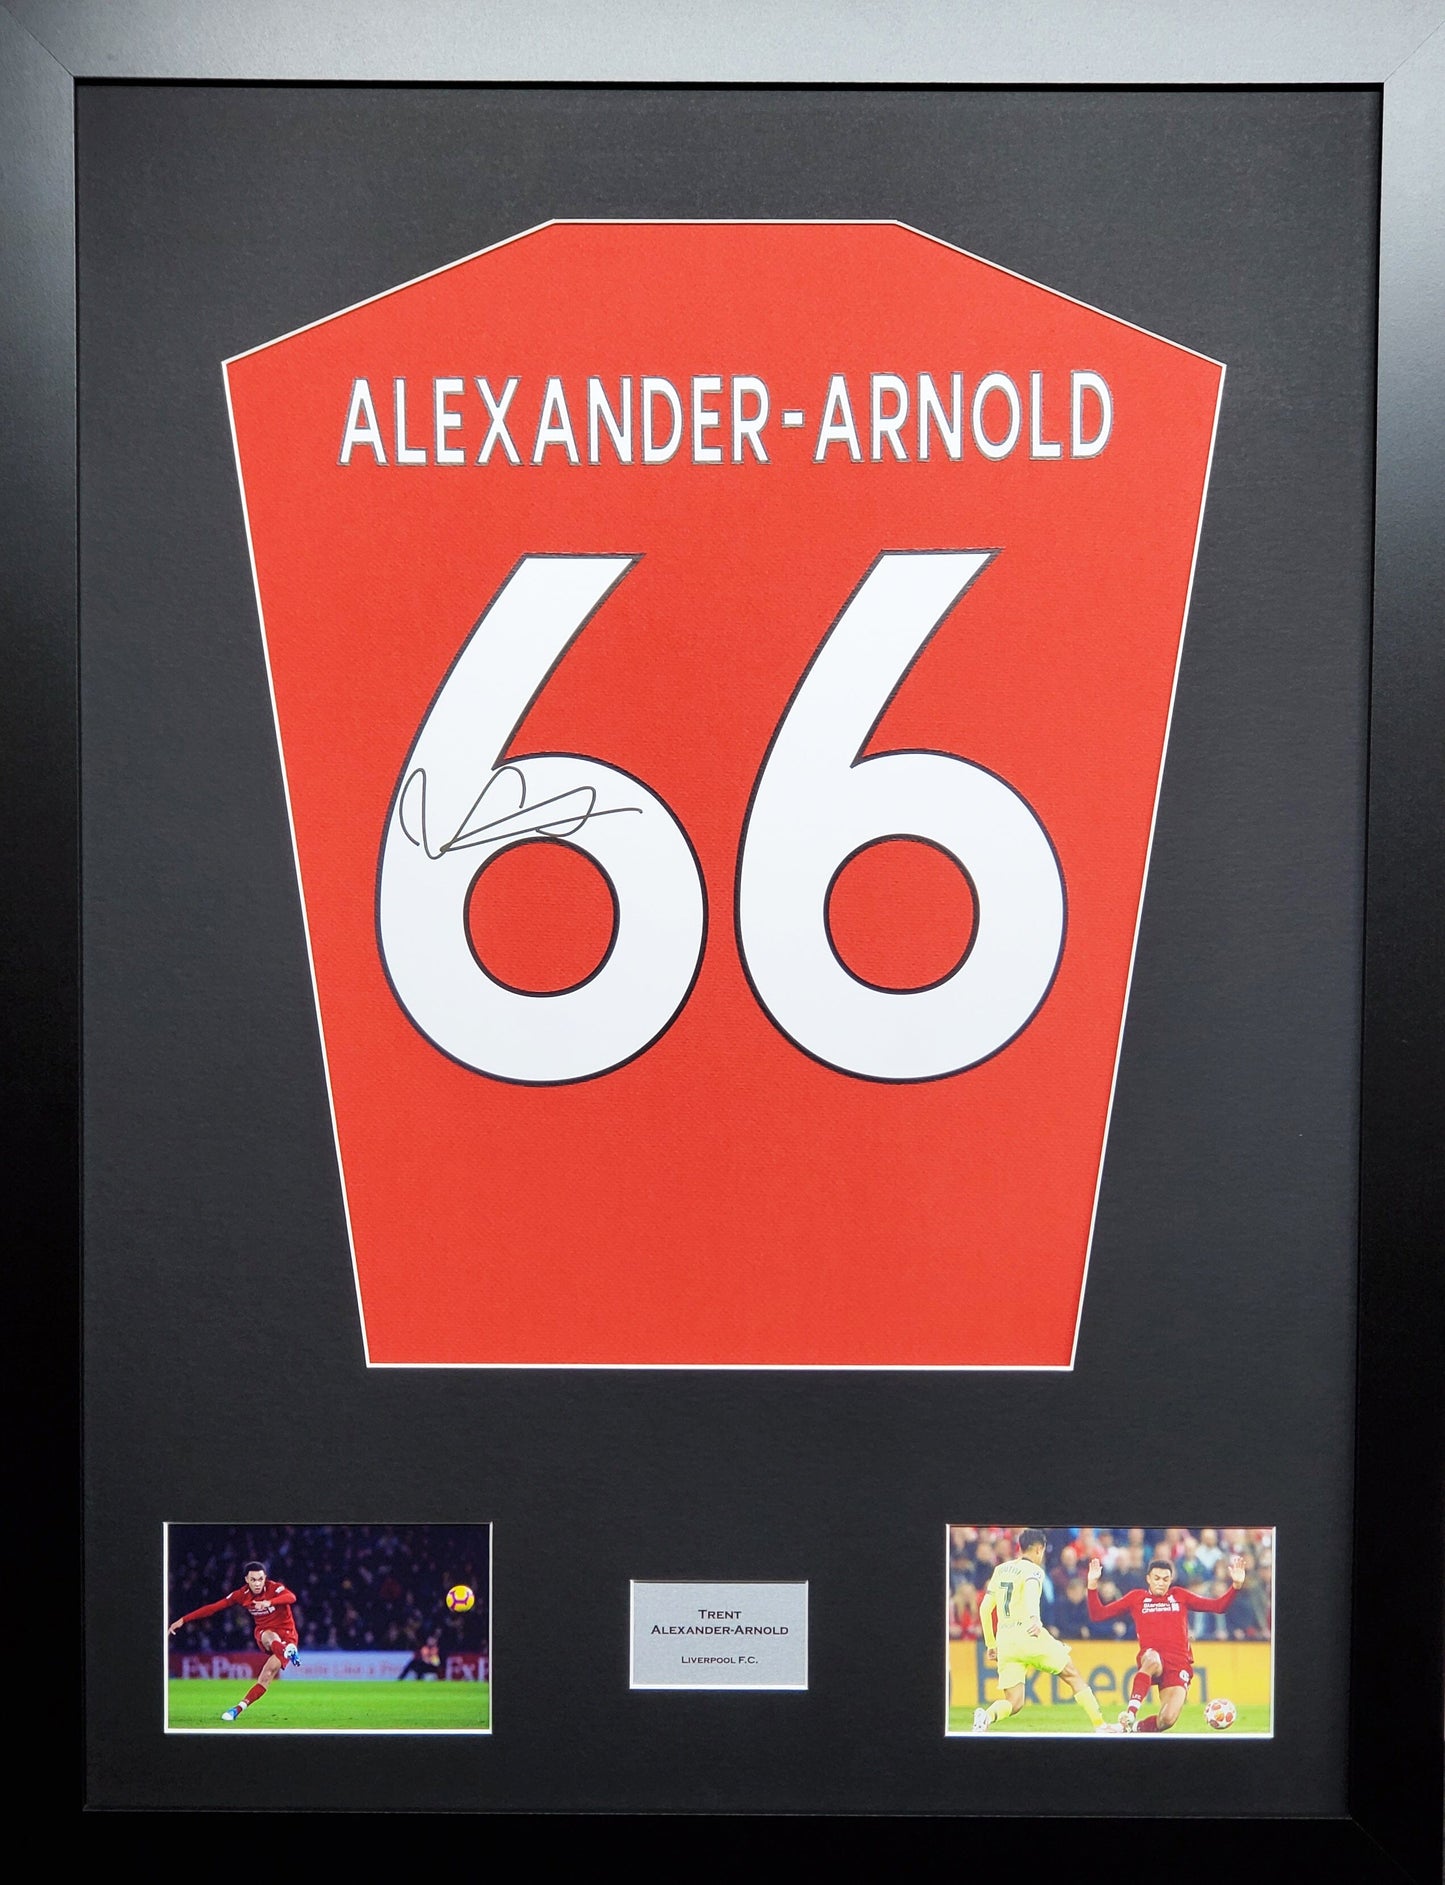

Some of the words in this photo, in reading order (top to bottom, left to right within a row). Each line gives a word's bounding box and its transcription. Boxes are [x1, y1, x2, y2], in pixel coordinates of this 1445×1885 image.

[336, 368, 1115, 467] ALEXANDER-ARNOLD
[373, 549, 1069, 1087] 66
[1000, 1581, 1014, 1617] 7
[697, 1609, 742, 1619] TRENT
[650, 1624, 789, 1635] ALEXANDER-ARNOLD
[681, 1656, 736, 1664] LIVERPOOL
[738, 1656, 758, 1664] F.C.
